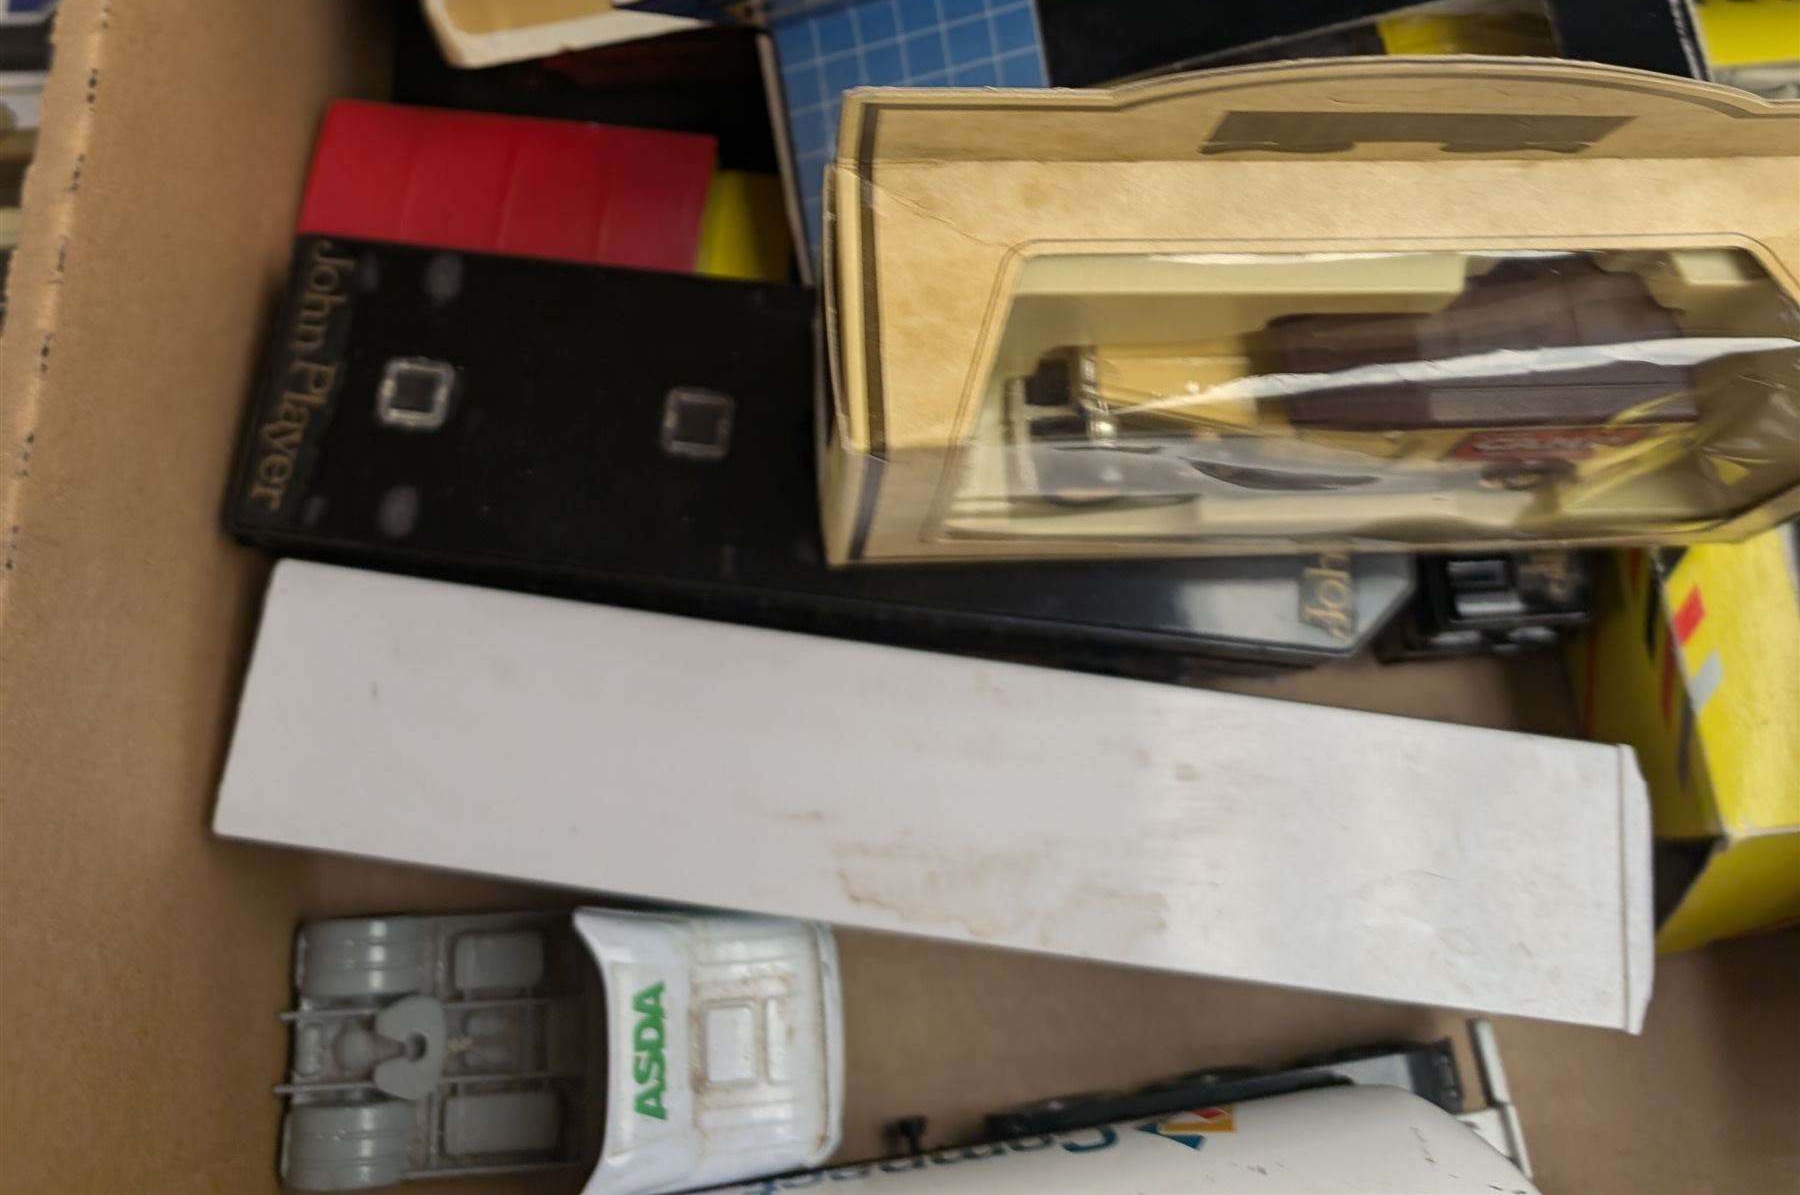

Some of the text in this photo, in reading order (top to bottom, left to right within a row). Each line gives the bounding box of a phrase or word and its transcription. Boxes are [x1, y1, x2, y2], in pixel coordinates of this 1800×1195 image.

[251, 240, 355, 512] John Player
[632, 979, 668, 1121] ASDA
